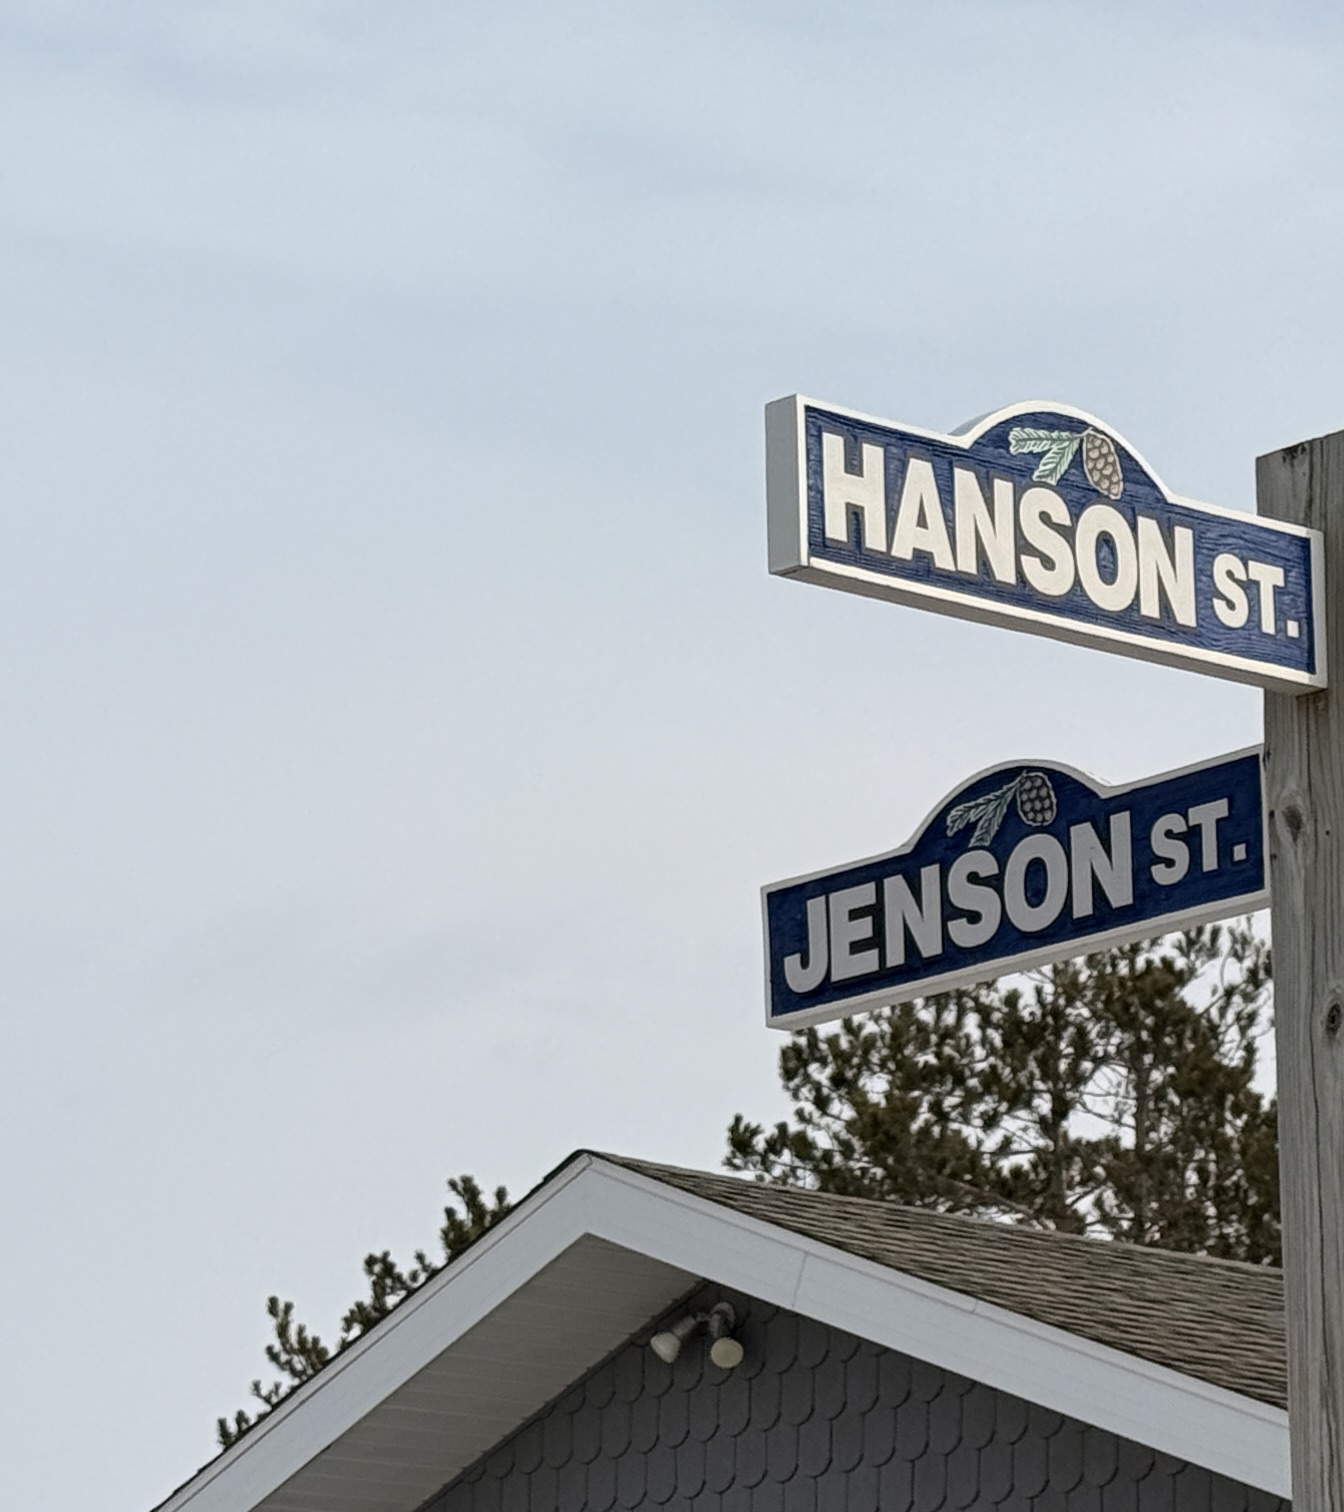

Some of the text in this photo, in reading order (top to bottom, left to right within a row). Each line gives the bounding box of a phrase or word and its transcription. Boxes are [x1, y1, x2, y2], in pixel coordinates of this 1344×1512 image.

[822, 432, 1300, 637] HANSON ST.
[783, 799, 1246, 993] JENSON ST.
